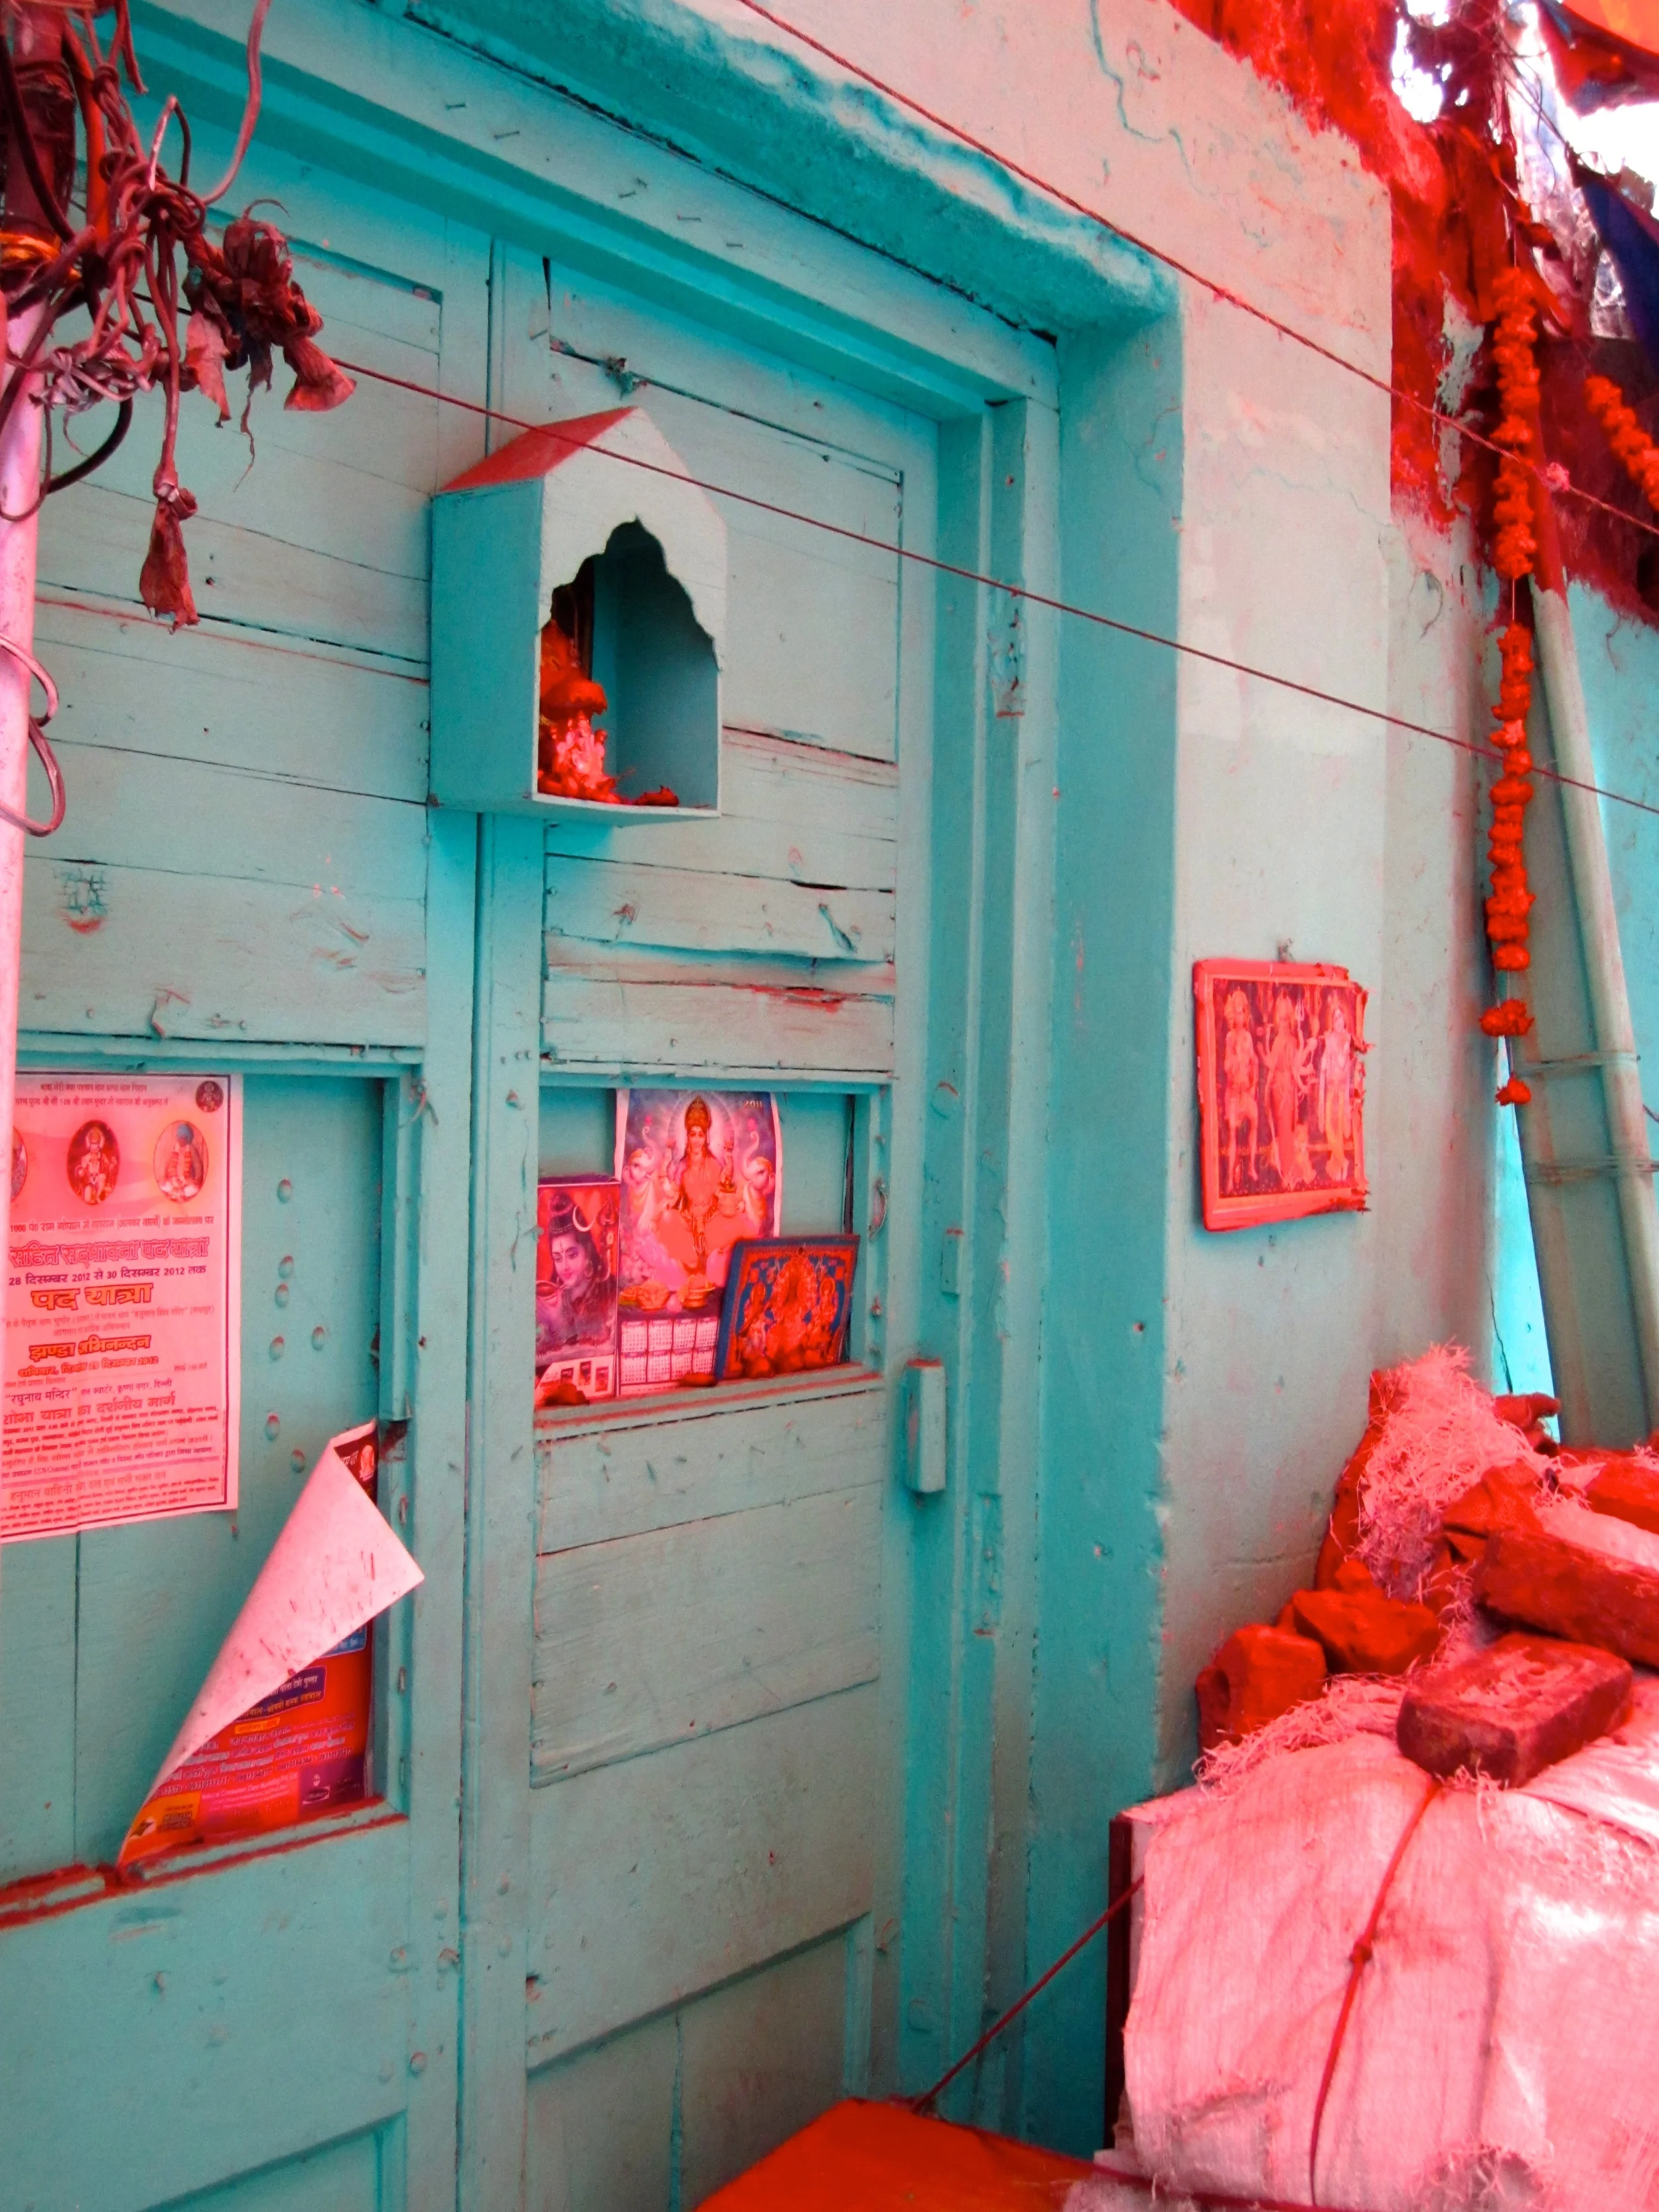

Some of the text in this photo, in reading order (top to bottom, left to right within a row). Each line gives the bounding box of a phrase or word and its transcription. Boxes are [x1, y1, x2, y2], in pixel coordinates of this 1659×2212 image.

[744, 1100, 763, 1108] 2011
[40, 1222, 54, 1232] राम
[57, 1218, 80, 1230] गोपाल
[205, 1216, 214, 1224] पर
[140, 1238, 169, 1260] पद
[169, 1236, 210, 1258] यात्रा
[9, 1265, 207, 1286] 28 दिसम्बर 2012 से 30 दिसम्बर 2012 तक
[31, 1282, 154, 1311] पद यात्रा
[29, 1333, 152, 1363] झण्डा अभिनन्दन
[154, 1378, 172, 1389] दिल्ली
[40, 1408, 72, 1420] यात्रा
[77, 1404, 91, 1416] का
[96, 1396, 143, 1414] दर्शनीय
[147, 1390, 176, 1408] मार्ग
